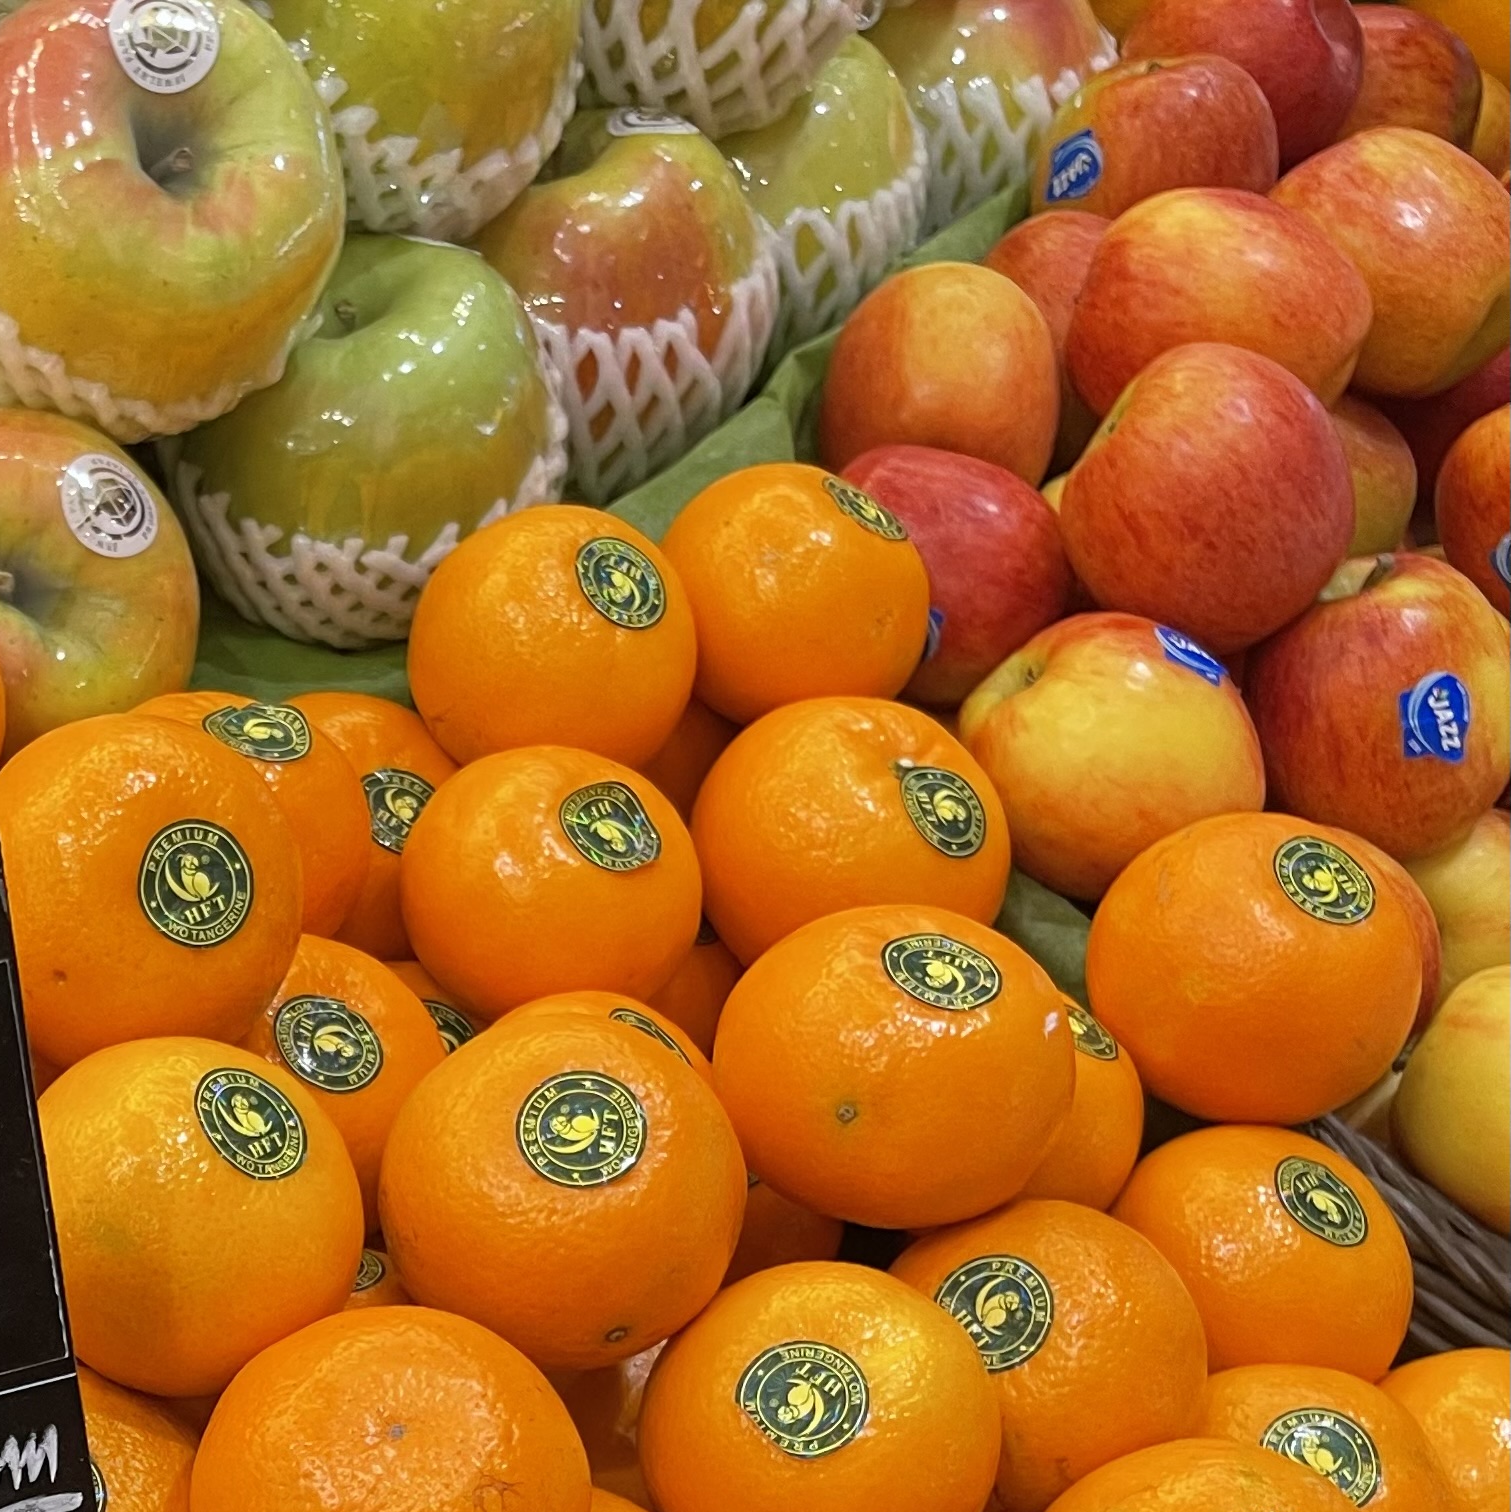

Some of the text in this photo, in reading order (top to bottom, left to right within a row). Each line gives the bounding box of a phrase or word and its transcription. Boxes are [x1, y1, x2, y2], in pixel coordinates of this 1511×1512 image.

[1427, 695, 1462, 752] JAZZ
[148, 831, 219, 872] PREMIUM
[166, 891, 246, 941] WO TANGERINE
[182, 894, 226, 925] HFT
[346, 1023, 378, 1085] PREMIUM
[200, 1075, 260, 1110] PREMIUM
[246, 1132, 284, 1158] HFT
[524, 1087, 558, 1167] PREMIUM
[599, 1108, 620, 1154] HFT
[992, 1261, 1046, 1323] PREMIUM
[954, 1309, 992, 1348] HFT
[793, 1362, 844, 1397] HFT
